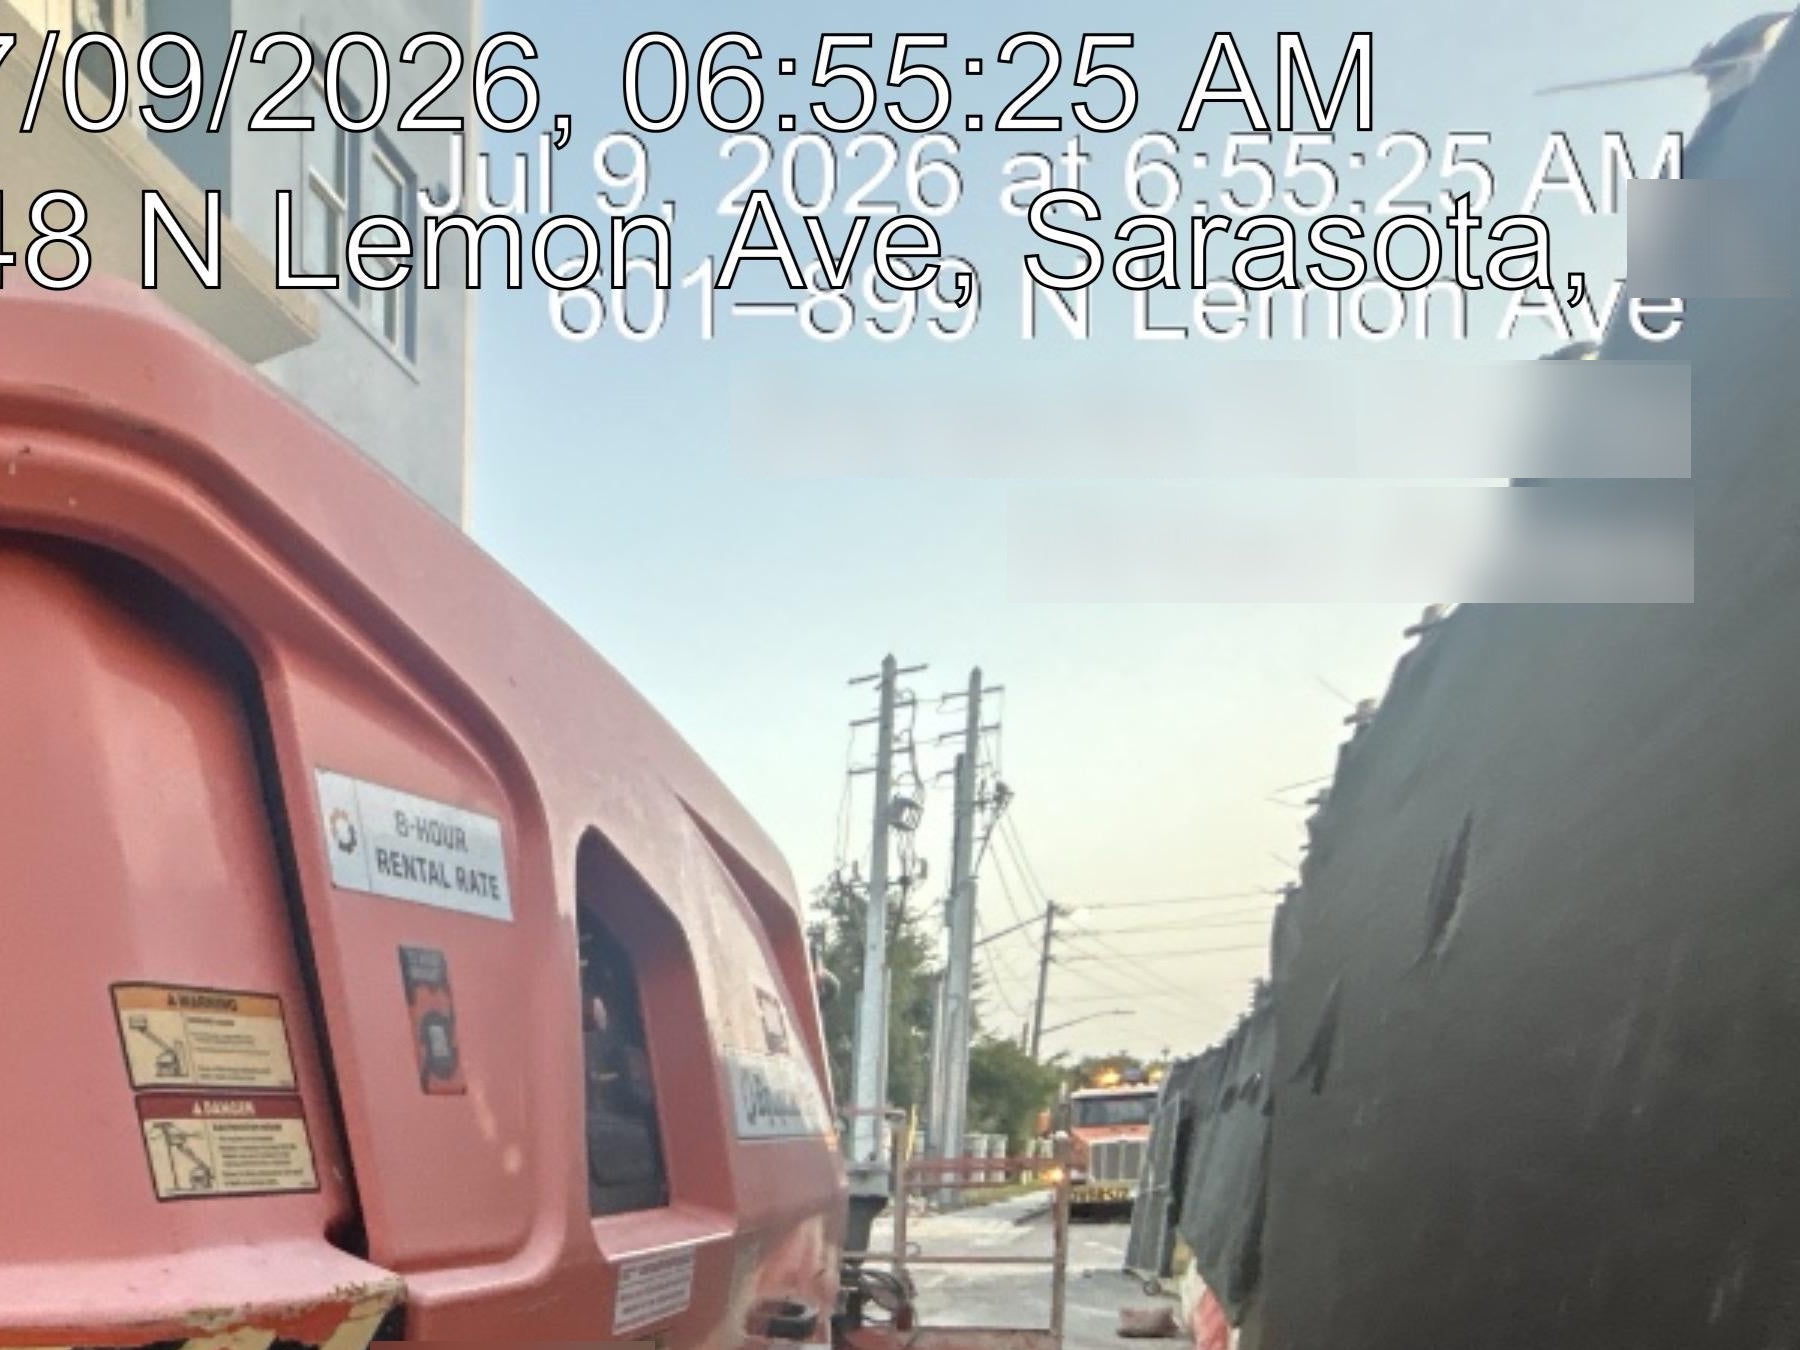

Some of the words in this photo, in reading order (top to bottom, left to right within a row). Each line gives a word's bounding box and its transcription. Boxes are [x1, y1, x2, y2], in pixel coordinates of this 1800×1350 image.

[395, 809, 468, 853] 8-HOUR
[375, 848, 451, 888] RENTAL
[455, 865, 501, 901] RATE
